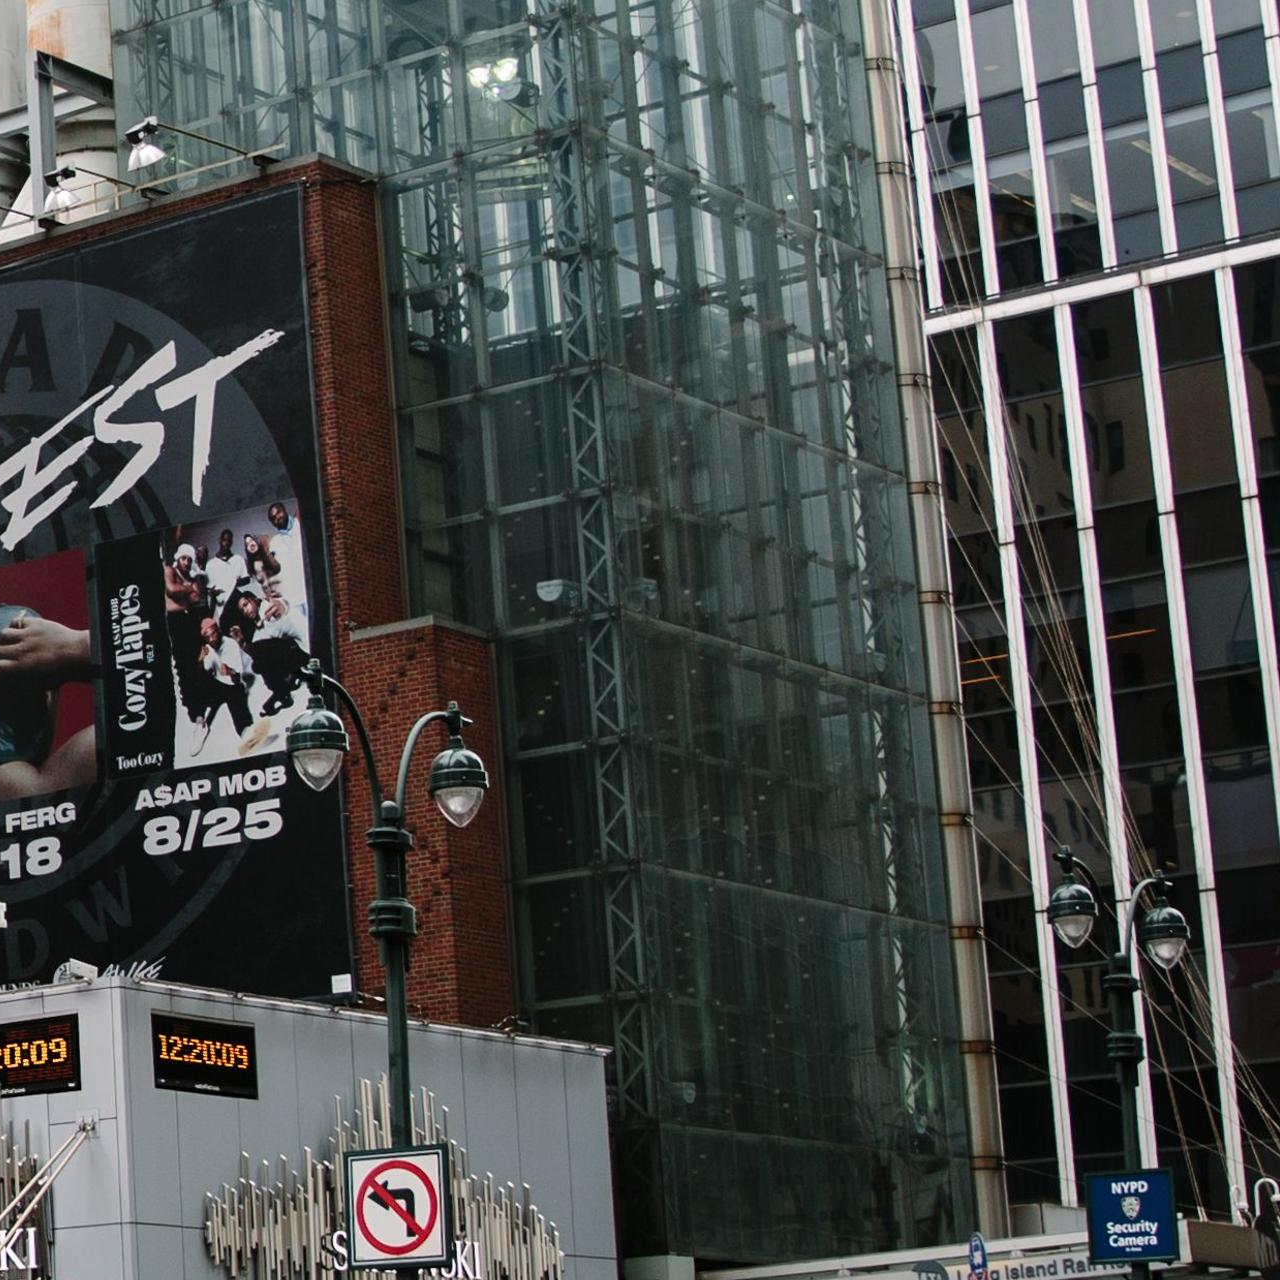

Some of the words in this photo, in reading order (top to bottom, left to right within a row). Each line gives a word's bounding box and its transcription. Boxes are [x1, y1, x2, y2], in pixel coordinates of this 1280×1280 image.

[115, 584, 151, 671] Tapes
[118, 669, 153, 732] Cozy
[116, 755, 137, 770] Too
[137, 751, 164, 767] Cozy
[134, 776, 213, 813] A$AP
[218, 765, 288, 799] MOB
[5, 802, 77, 834] FERG
[142, 798, 284, 856] 8/25
[1111, 1181, 1148, 1194] NYPD
[1106, 1220, 1158, 1235] Security
[1109, 1235, 1158, 1248] Camera
[1005, 1261, 1058, 1280] Island
